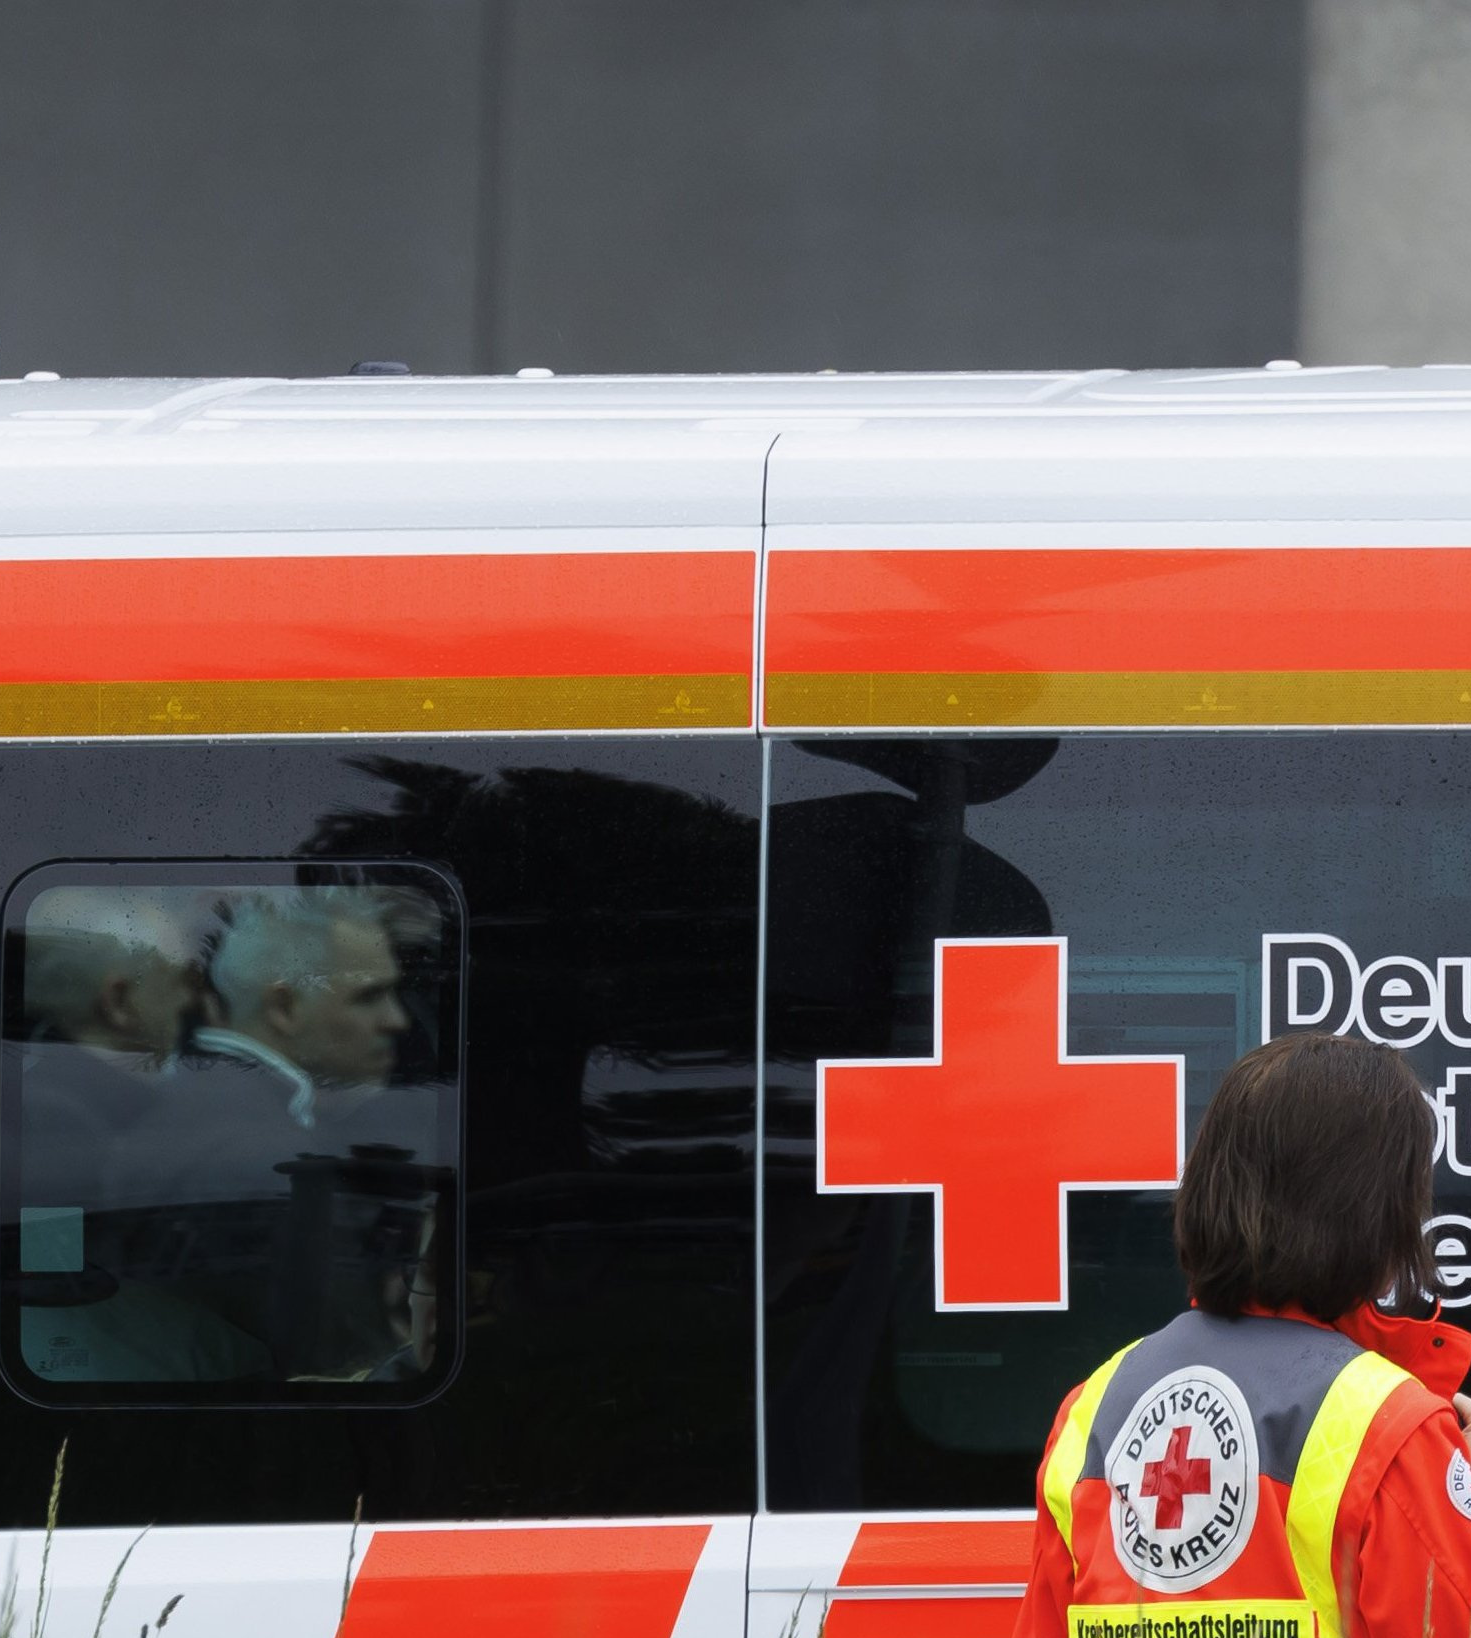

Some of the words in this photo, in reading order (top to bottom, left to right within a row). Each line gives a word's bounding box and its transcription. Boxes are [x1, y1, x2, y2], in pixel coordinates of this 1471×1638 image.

[1126, 1388, 1238, 1461] DEUTSCHES
[1116, 1483, 1164, 1567] ROTES
[1170, 1482, 1240, 1569] KREUZ
